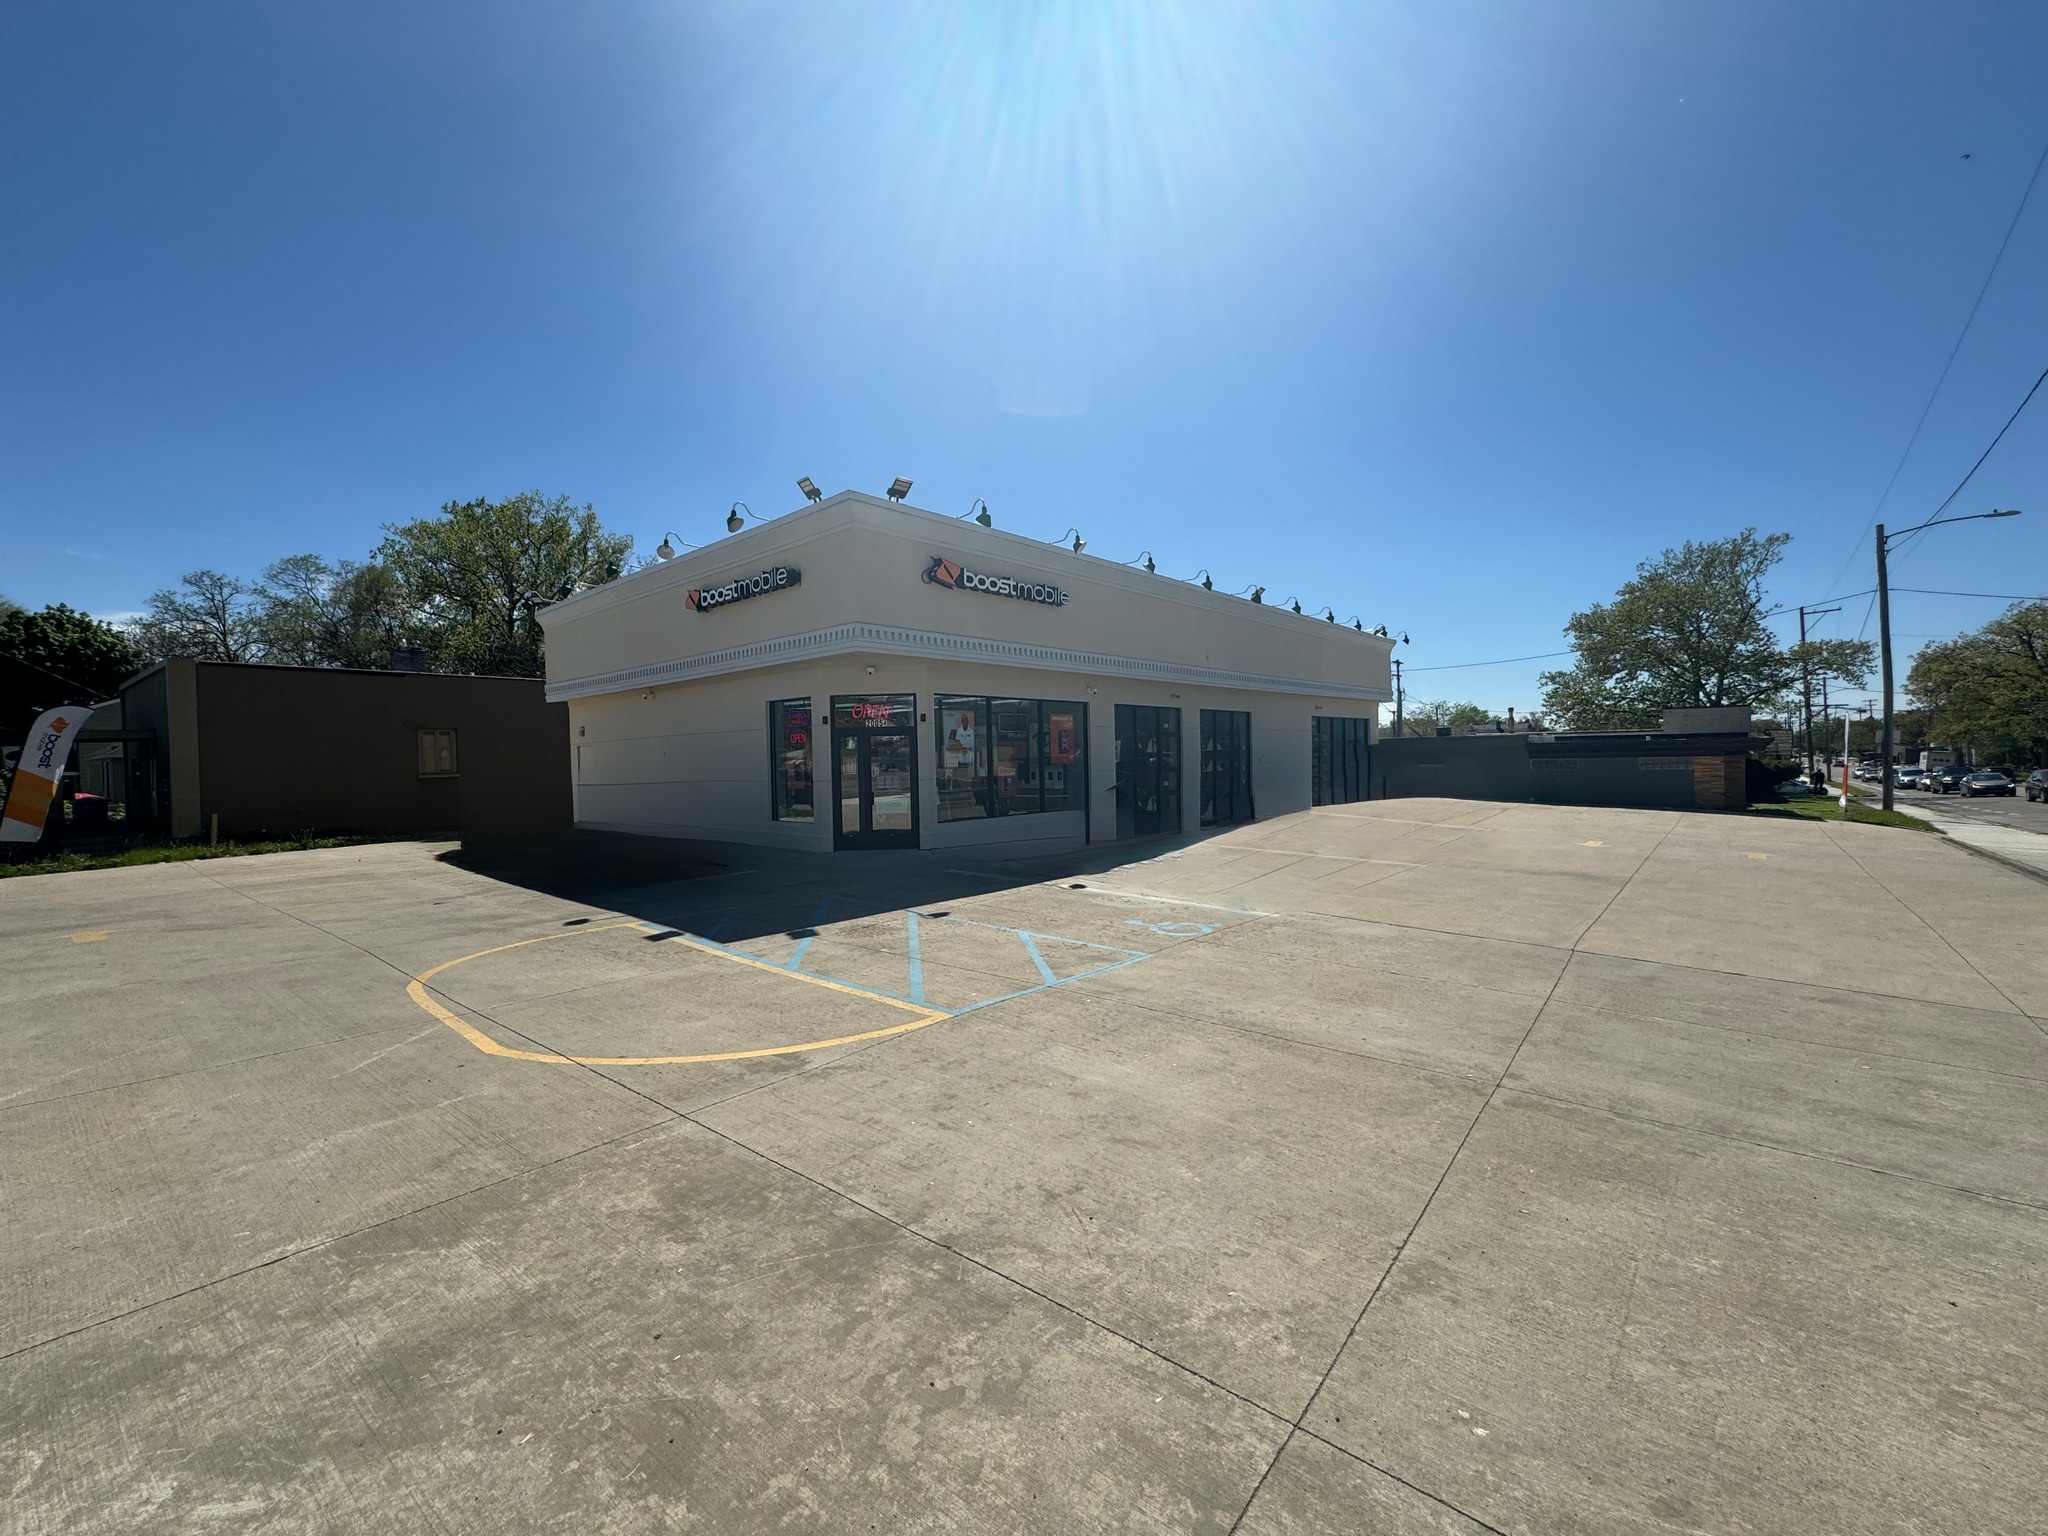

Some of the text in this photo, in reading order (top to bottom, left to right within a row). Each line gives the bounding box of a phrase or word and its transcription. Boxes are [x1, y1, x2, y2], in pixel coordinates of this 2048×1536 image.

[852, 703, 890, 719] OPEN
[790, 733, 807, 744] OPEN
[37, 733, 61, 769] boost
